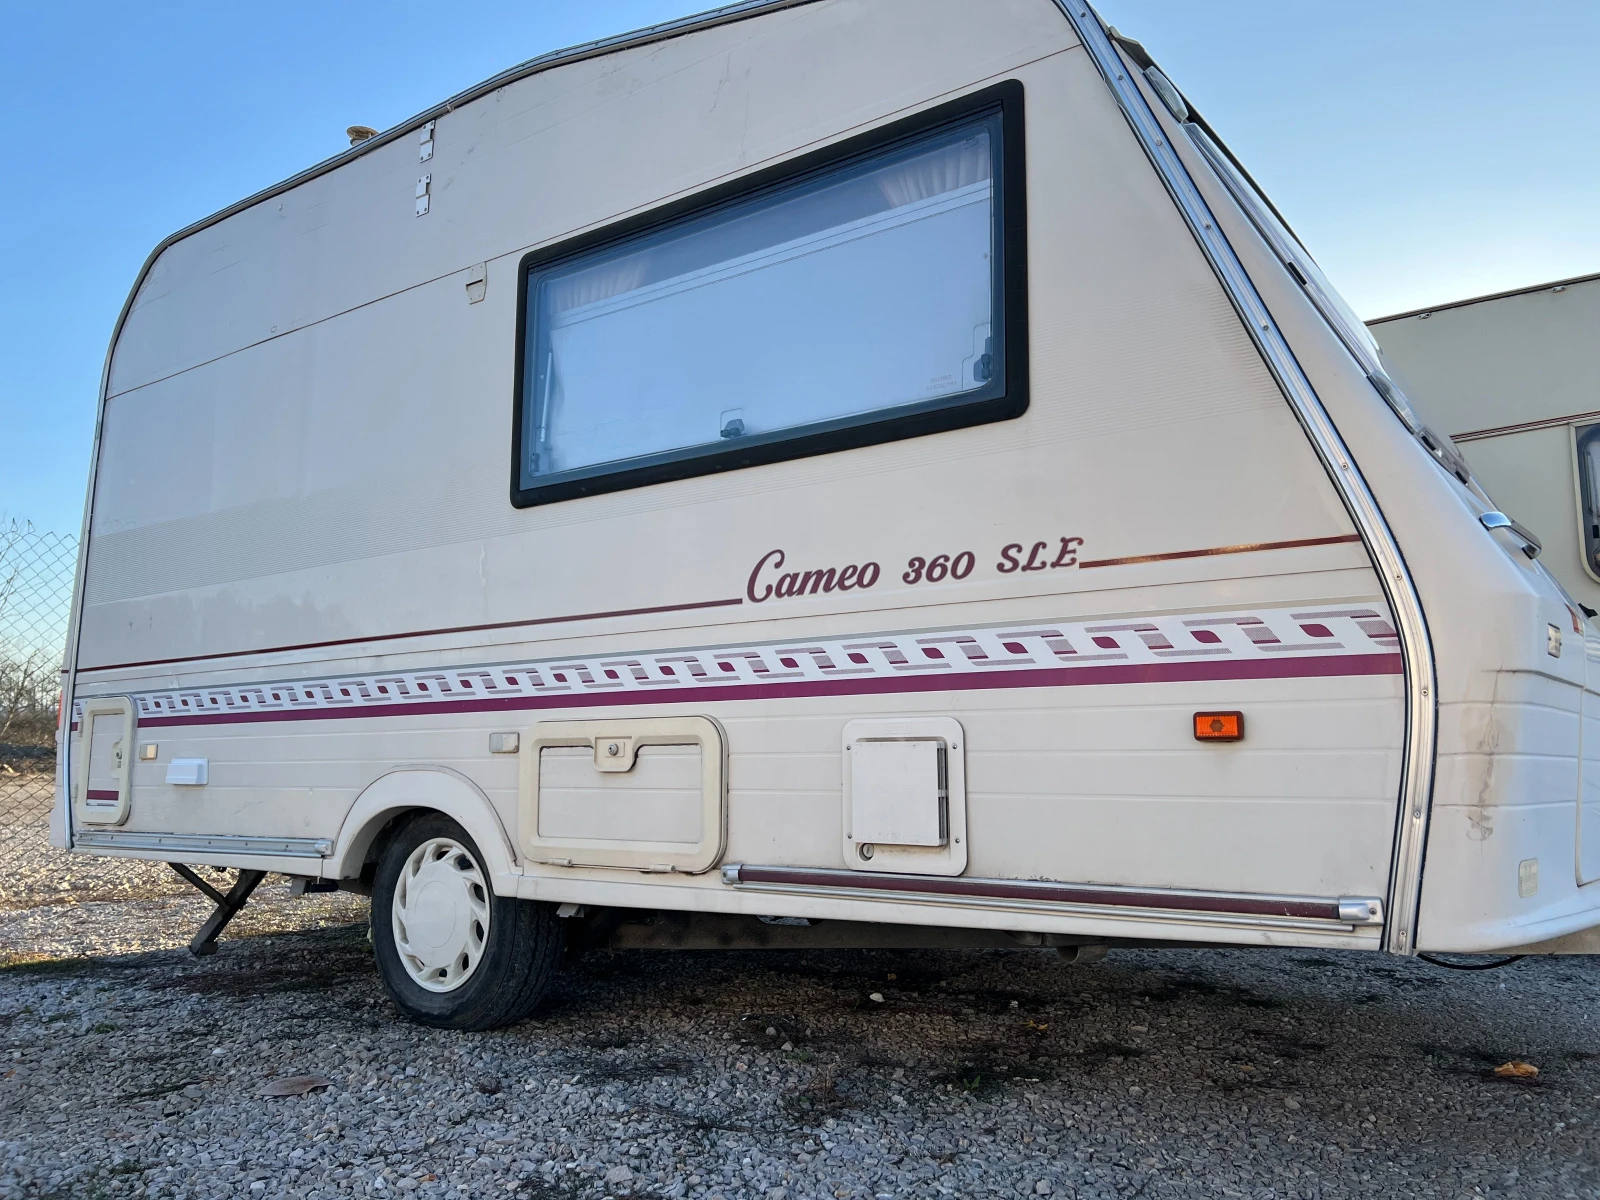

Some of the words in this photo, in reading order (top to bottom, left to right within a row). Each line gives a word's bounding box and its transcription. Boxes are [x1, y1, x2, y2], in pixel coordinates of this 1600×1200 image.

[747, 549, 880, 603] Cameo
[902, 551, 976, 585] 360
[996, 537, 1084, 574] SLE
